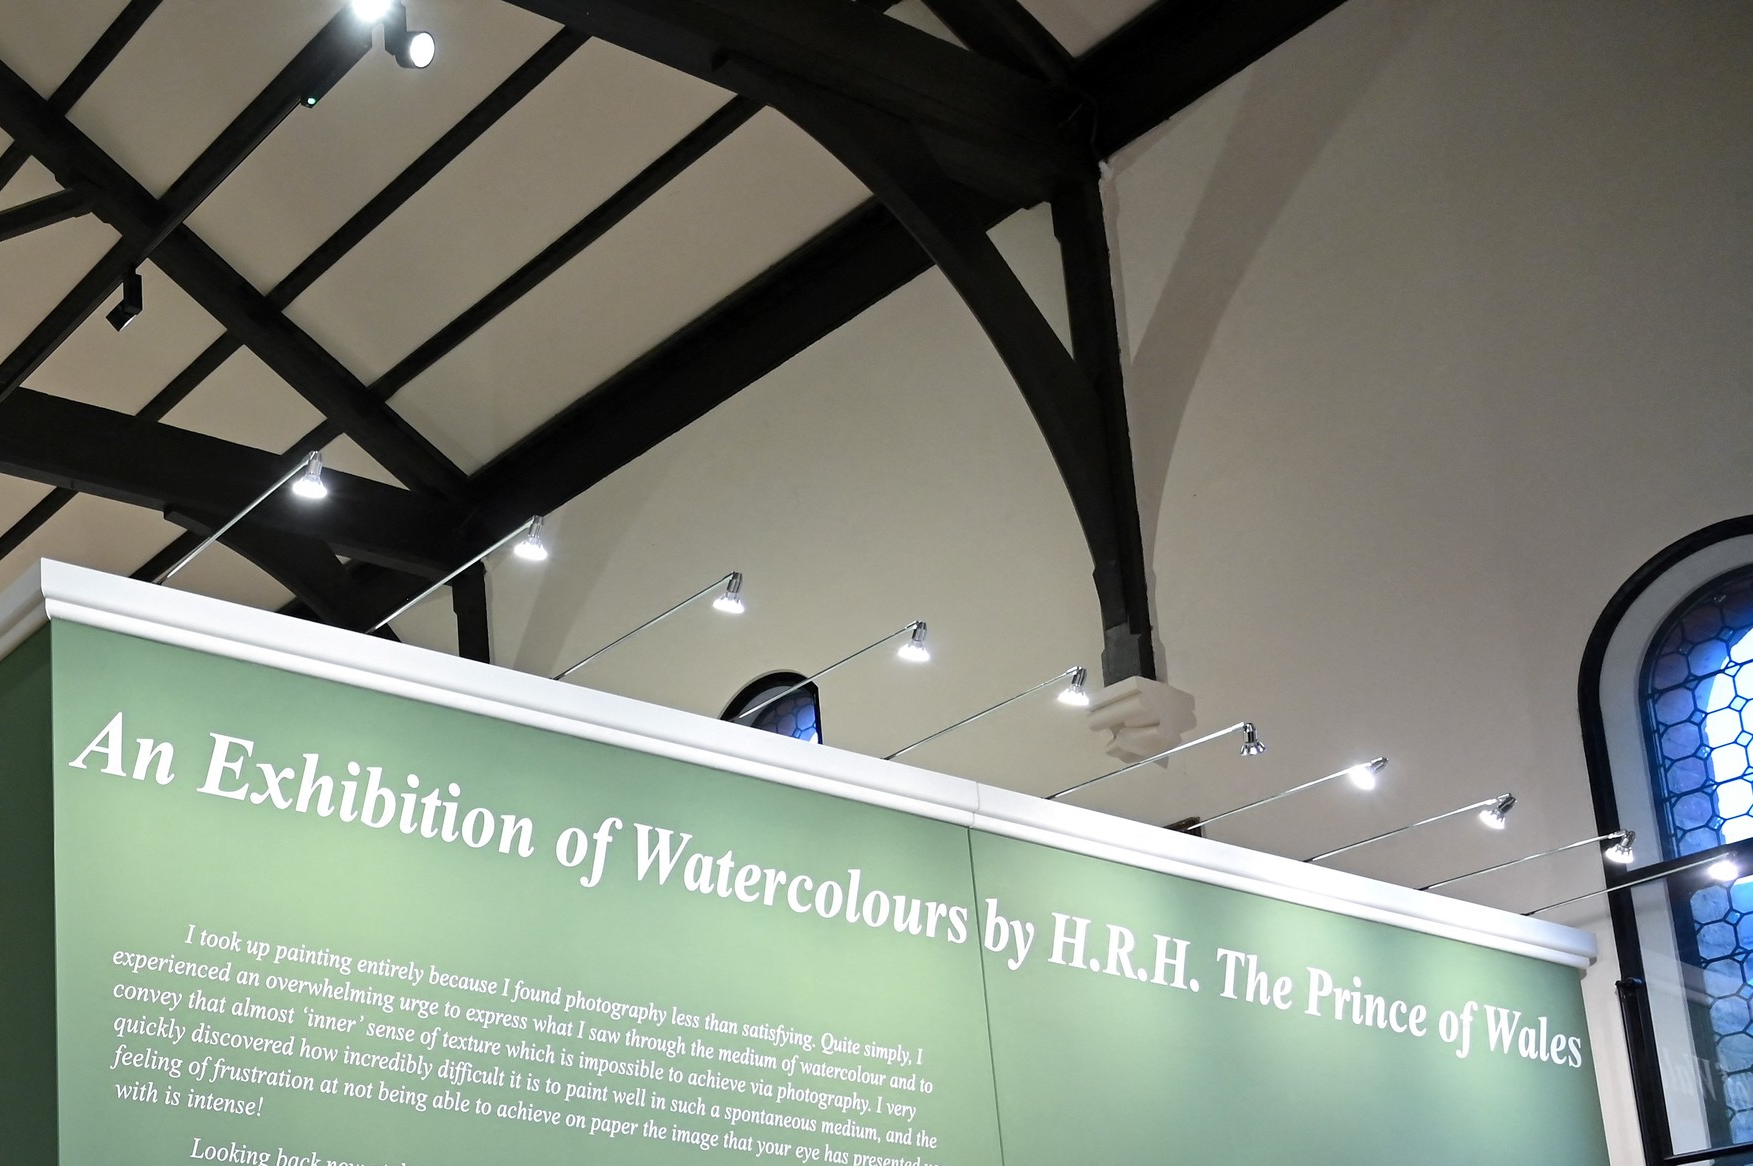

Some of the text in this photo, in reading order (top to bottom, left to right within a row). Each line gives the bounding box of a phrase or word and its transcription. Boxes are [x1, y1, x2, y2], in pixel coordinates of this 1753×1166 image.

[69, 712, 1581, 1067] An Exhibition of Watercolours by H.R.H. The Prince of Wales
[113, 984, 182, 1011] convey
[189, 990, 226, 1013] that
[232, 997, 295, 1024] almost
[366, 1023, 415, 1042] sense
[420, 1027, 441, 1050] of
[443, 1032, 500, 1055] texture
[506, 1041, 555, 1064] which
[561, 1048, 574, 1066] is
[579, 1051, 663, 1080] impossible
[669, 1067, 683, 1083] to
[688, 1070, 746, 1092] achieve
[750, 1079, 773, 1097] via
[776, 1082, 871, 1115] photography.
[876, 1097, 882, 1113] I
[886, 1103, 916, 1122] very
[185, 925, 922, 1066] I took up painting entirely because I found photography less than satisfying. Quite simply, I
[110, 1044, 183, 1078] feeling
[189, 1056, 212, 1081] of
[209, 1058, 314, 1091] frustration
[320, 1078, 338, 1094] at
[344, 1083, 373, 1099] not
[378, 1081, 428, 1111] being
[433, 1090, 470, 1112] able
[476, 1098, 491, 1115] to
[497, 1101, 561, 1125] achieve
[566, 1114, 585, 1128] on
[589, 1118, 638, 1137] paper
[643, 1120, 667, 1139] the
[672, 1124, 718, 1150] image
[724, 1131, 753, 1151] that
[756, 1141, 791, 1157] your
[796, 1146, 820, 1163] eye
[824, 1144, 848, 1164] has
[115, 1081, 263, 1116] with is intense!
